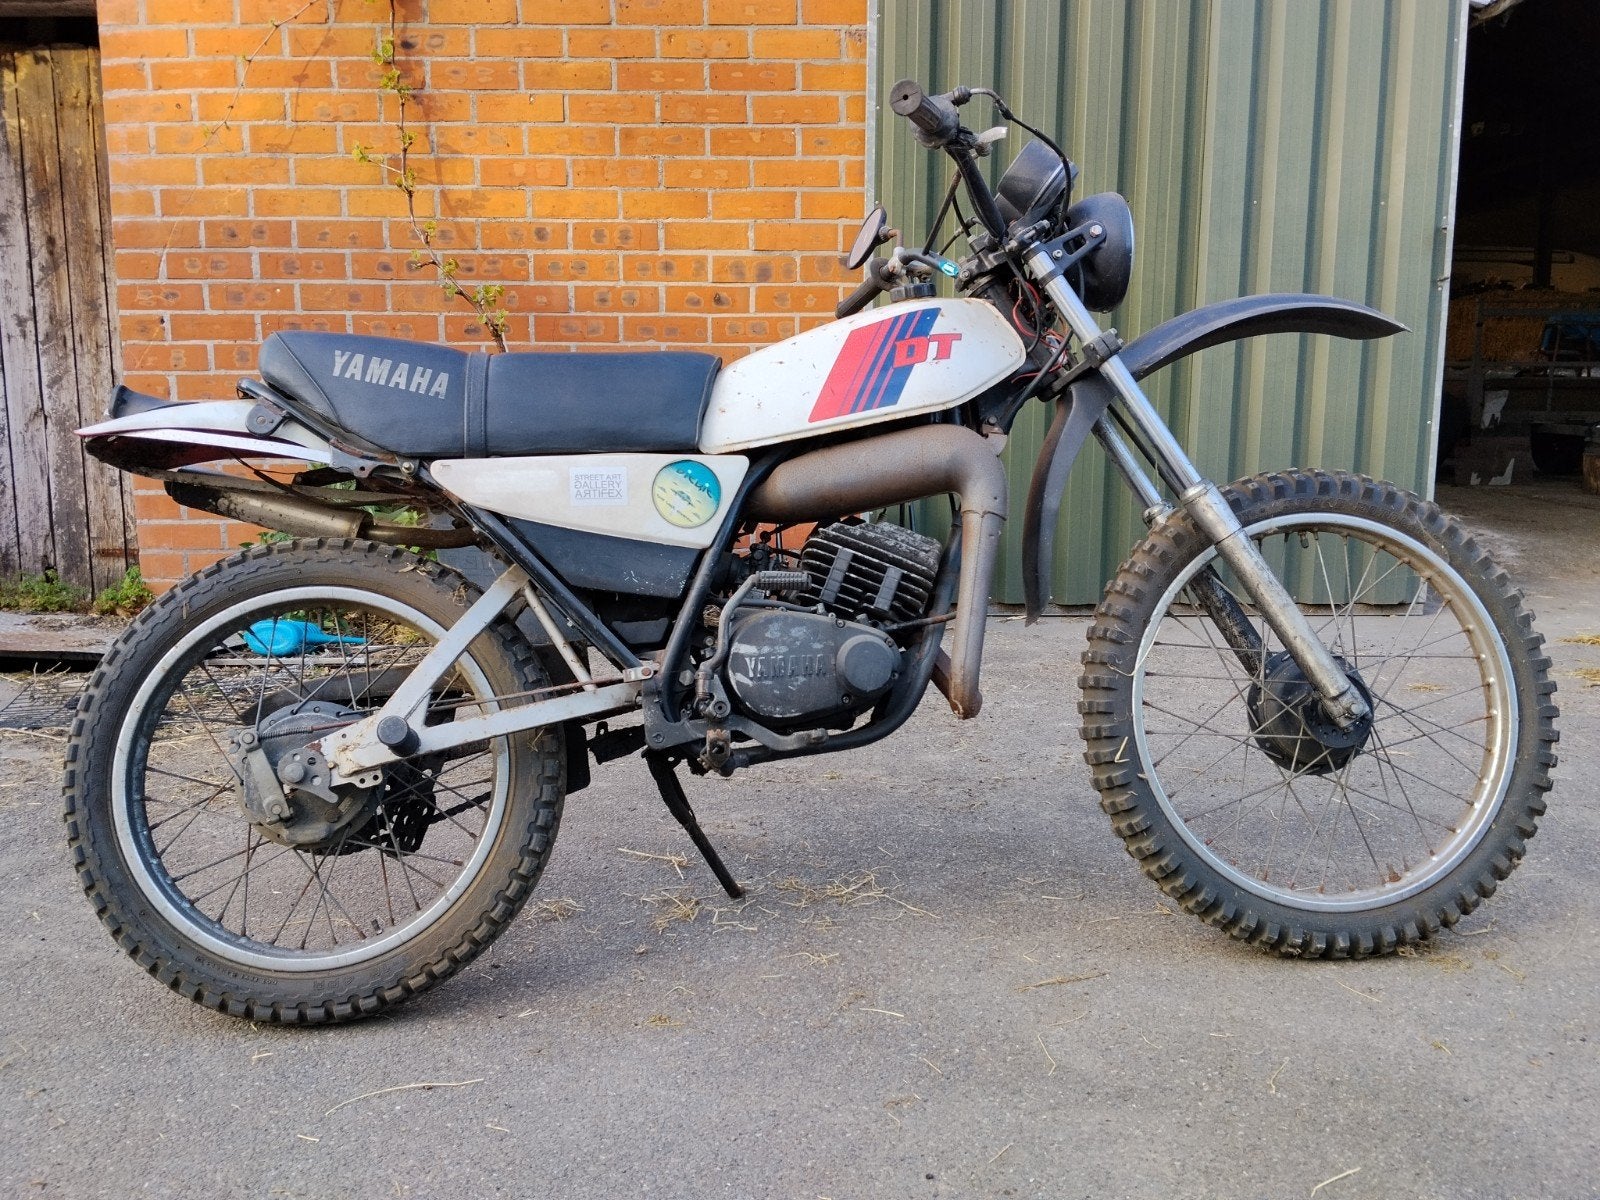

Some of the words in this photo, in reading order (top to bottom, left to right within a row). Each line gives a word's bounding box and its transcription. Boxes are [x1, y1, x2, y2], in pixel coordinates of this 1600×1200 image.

[893, 333, 962, 369] DT
[332, 349, 450, 400] YAMAHA
[574, 480, 622, 489] GALLERY
[575, 489, 623, 498] ARTIFEX
[744, 653, 828, 678] YAMAHA
